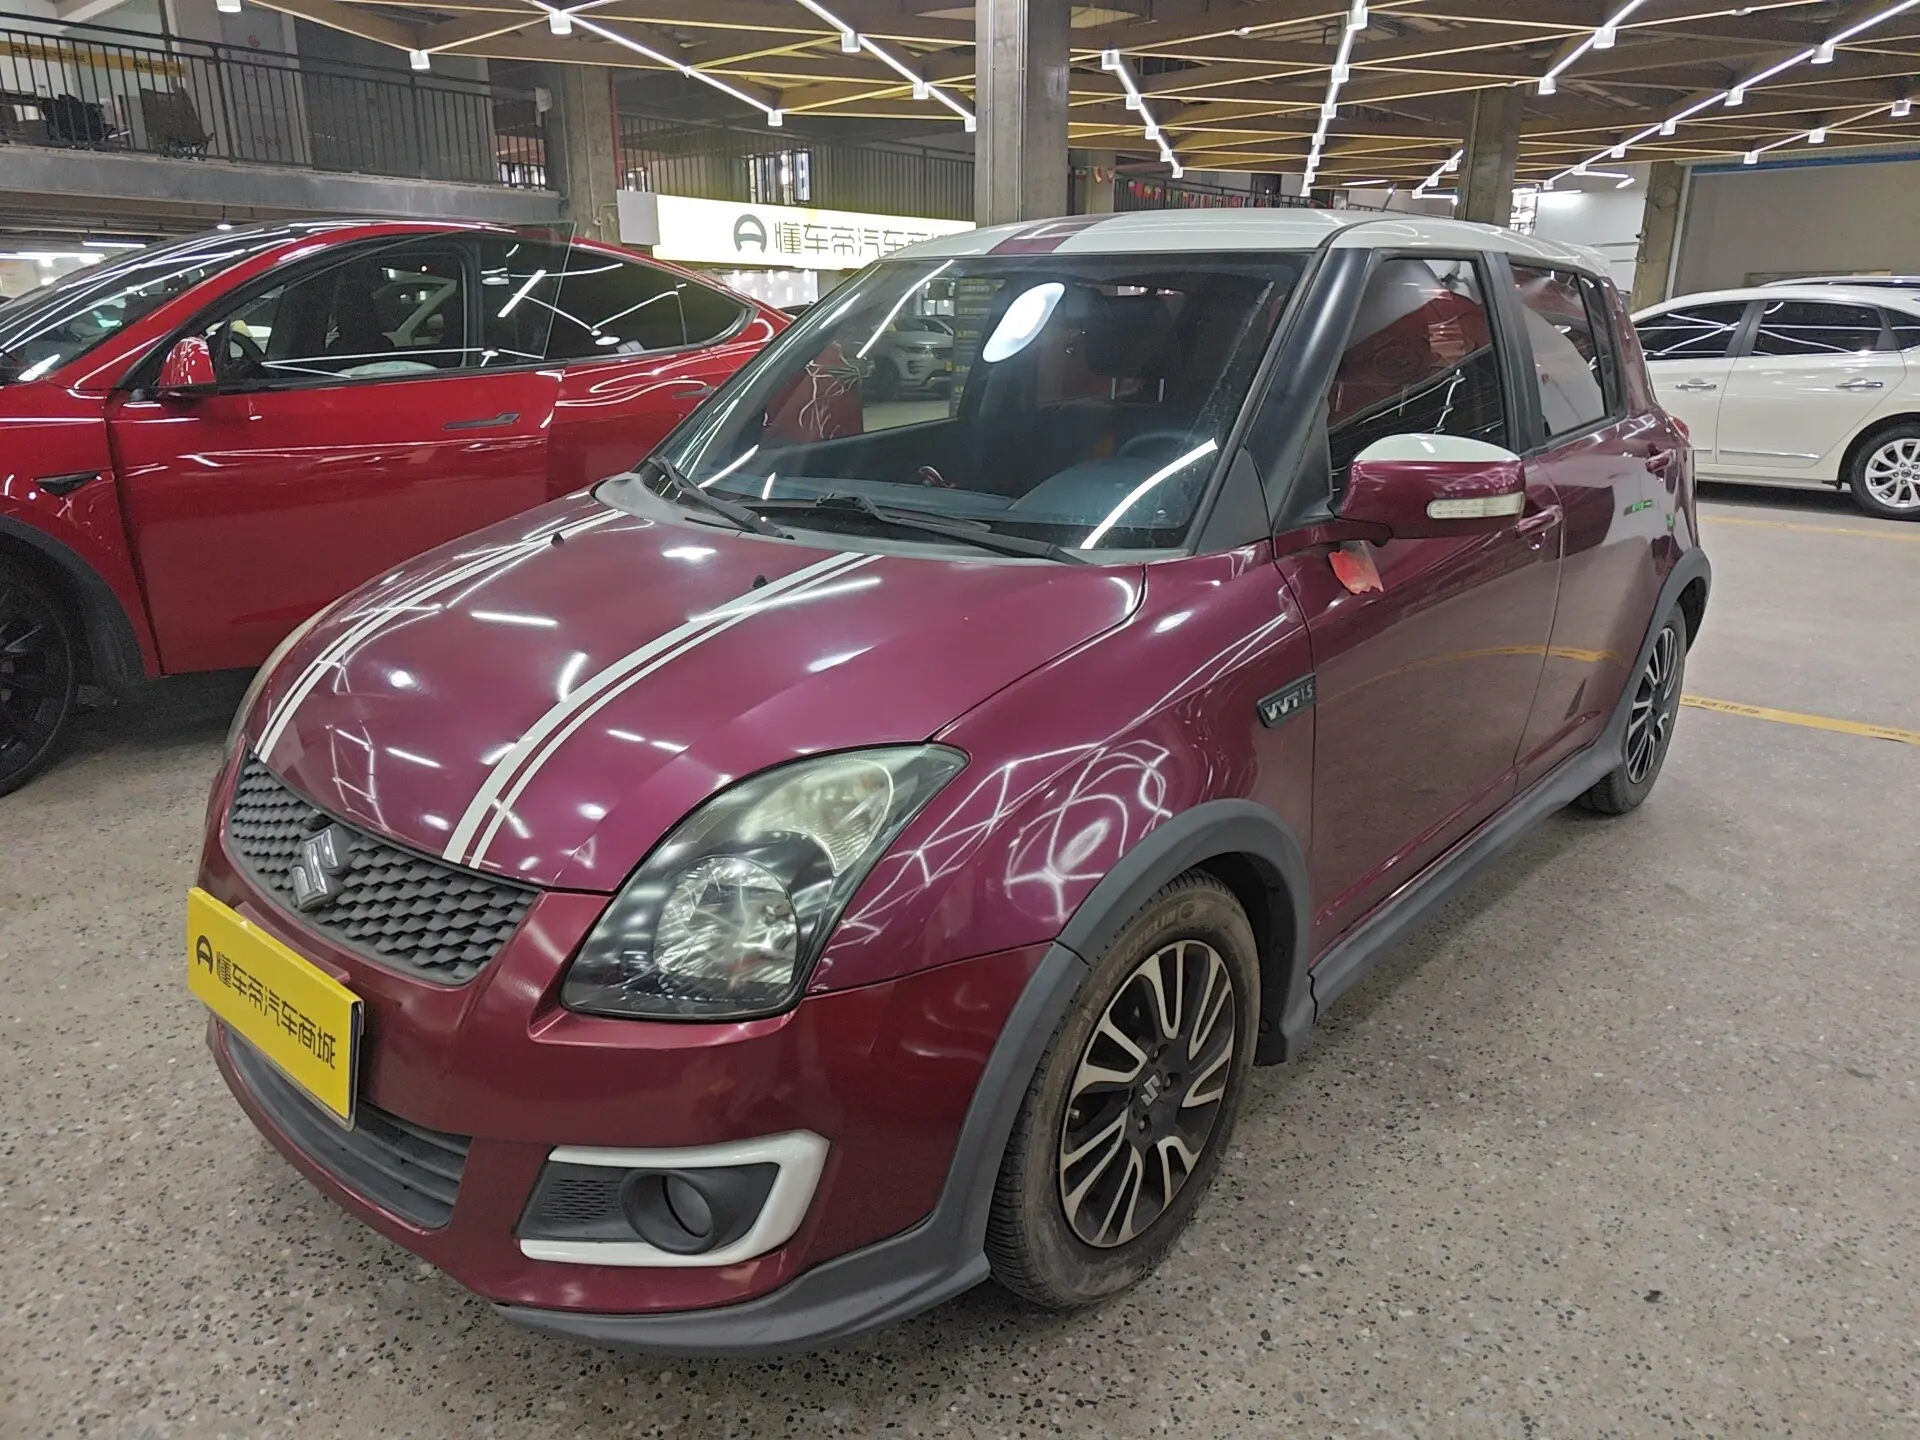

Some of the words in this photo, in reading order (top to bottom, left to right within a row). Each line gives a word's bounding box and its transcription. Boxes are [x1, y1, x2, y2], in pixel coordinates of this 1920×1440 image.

[216, 951, 336, 1070] 懂车帝汽车商城
